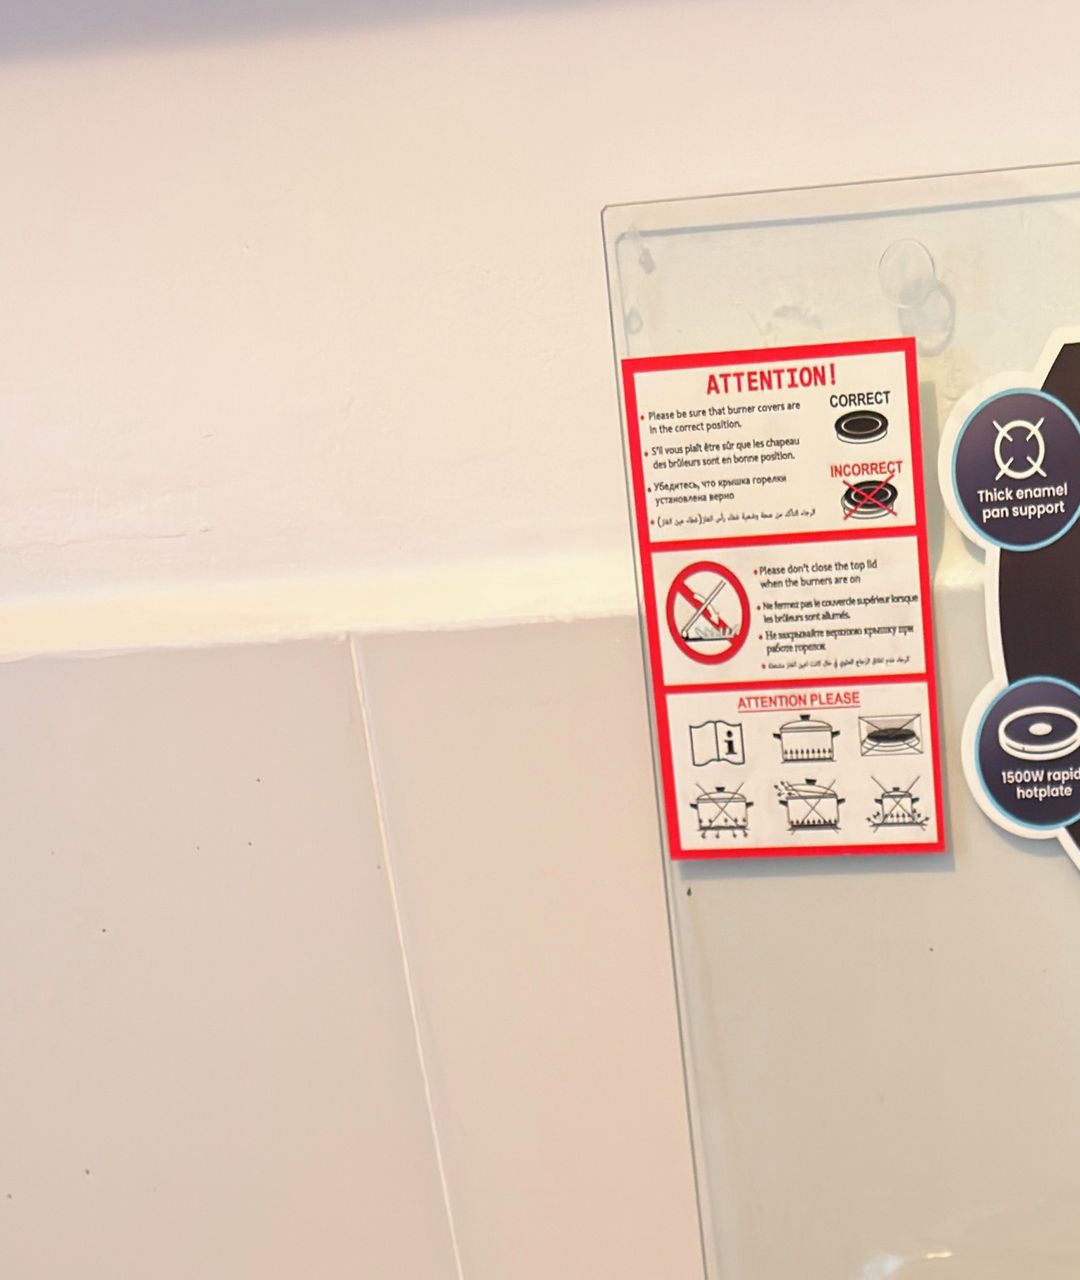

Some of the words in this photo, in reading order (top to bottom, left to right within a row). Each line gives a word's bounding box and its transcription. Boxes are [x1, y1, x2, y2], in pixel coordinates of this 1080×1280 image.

[706, 363, 837, 395] ATTENTION!
[829, 391, 891, 408] CORRECT
[648, 411, 675, 420] Please
[676, 409, 687, 419] be
[689, 409, 707, 418] sure
[708, 406, 726, 416] that
[727, 405, 756, 415] burner
[758, 403, 785, 412] covers
[787, 402, 800, 410] are
[649, 425, 657, 434] in
[659, 424, 673, 434] the
[675, 422, 704, 433] correct
[665, 446, 683, 454] vous
[704, 443, 720, 452] être
[736, 441, 751, 451] que
[752, 439, 764, 448] les
[766, 438, 800, 449] chapeau
[653, 461, 667, 469] des
[702, 457, 720, 466] sont
[733, 454, 759, 464] bonne
[830, 461, 903, 478] INCORRECT
[701, 480, 716, 488] что
[709, 492, 735, 503] верно
[977, 488, 1013, 503] Thick
[1015, 482, 1068, 499] enamel
[982, 506, 1009, 523] pan
[1012, 500, 1065, 520] support
[760, 566, 786, 575] Please
[787, 563, 810, 574] don't
[811, 562, 833, 572] close
[834, 561, 848, 571] the
[850, 561, 866, 572] top
[867, 559, 878, 569] lid
[760, 579, 783, 589] when
[784, 578, 799, 587] the
[800, 576, 833, 586] burners
[834, 576, 848, 584] are
[849, 575, 861, 584] on
[738, 694, 807, 709] ATTENTION
[810, 691, 861, 706] PLEASE
[1001, 769, 1045, 784] 1500W
[1016, 785, 1073, 801] hotplate
